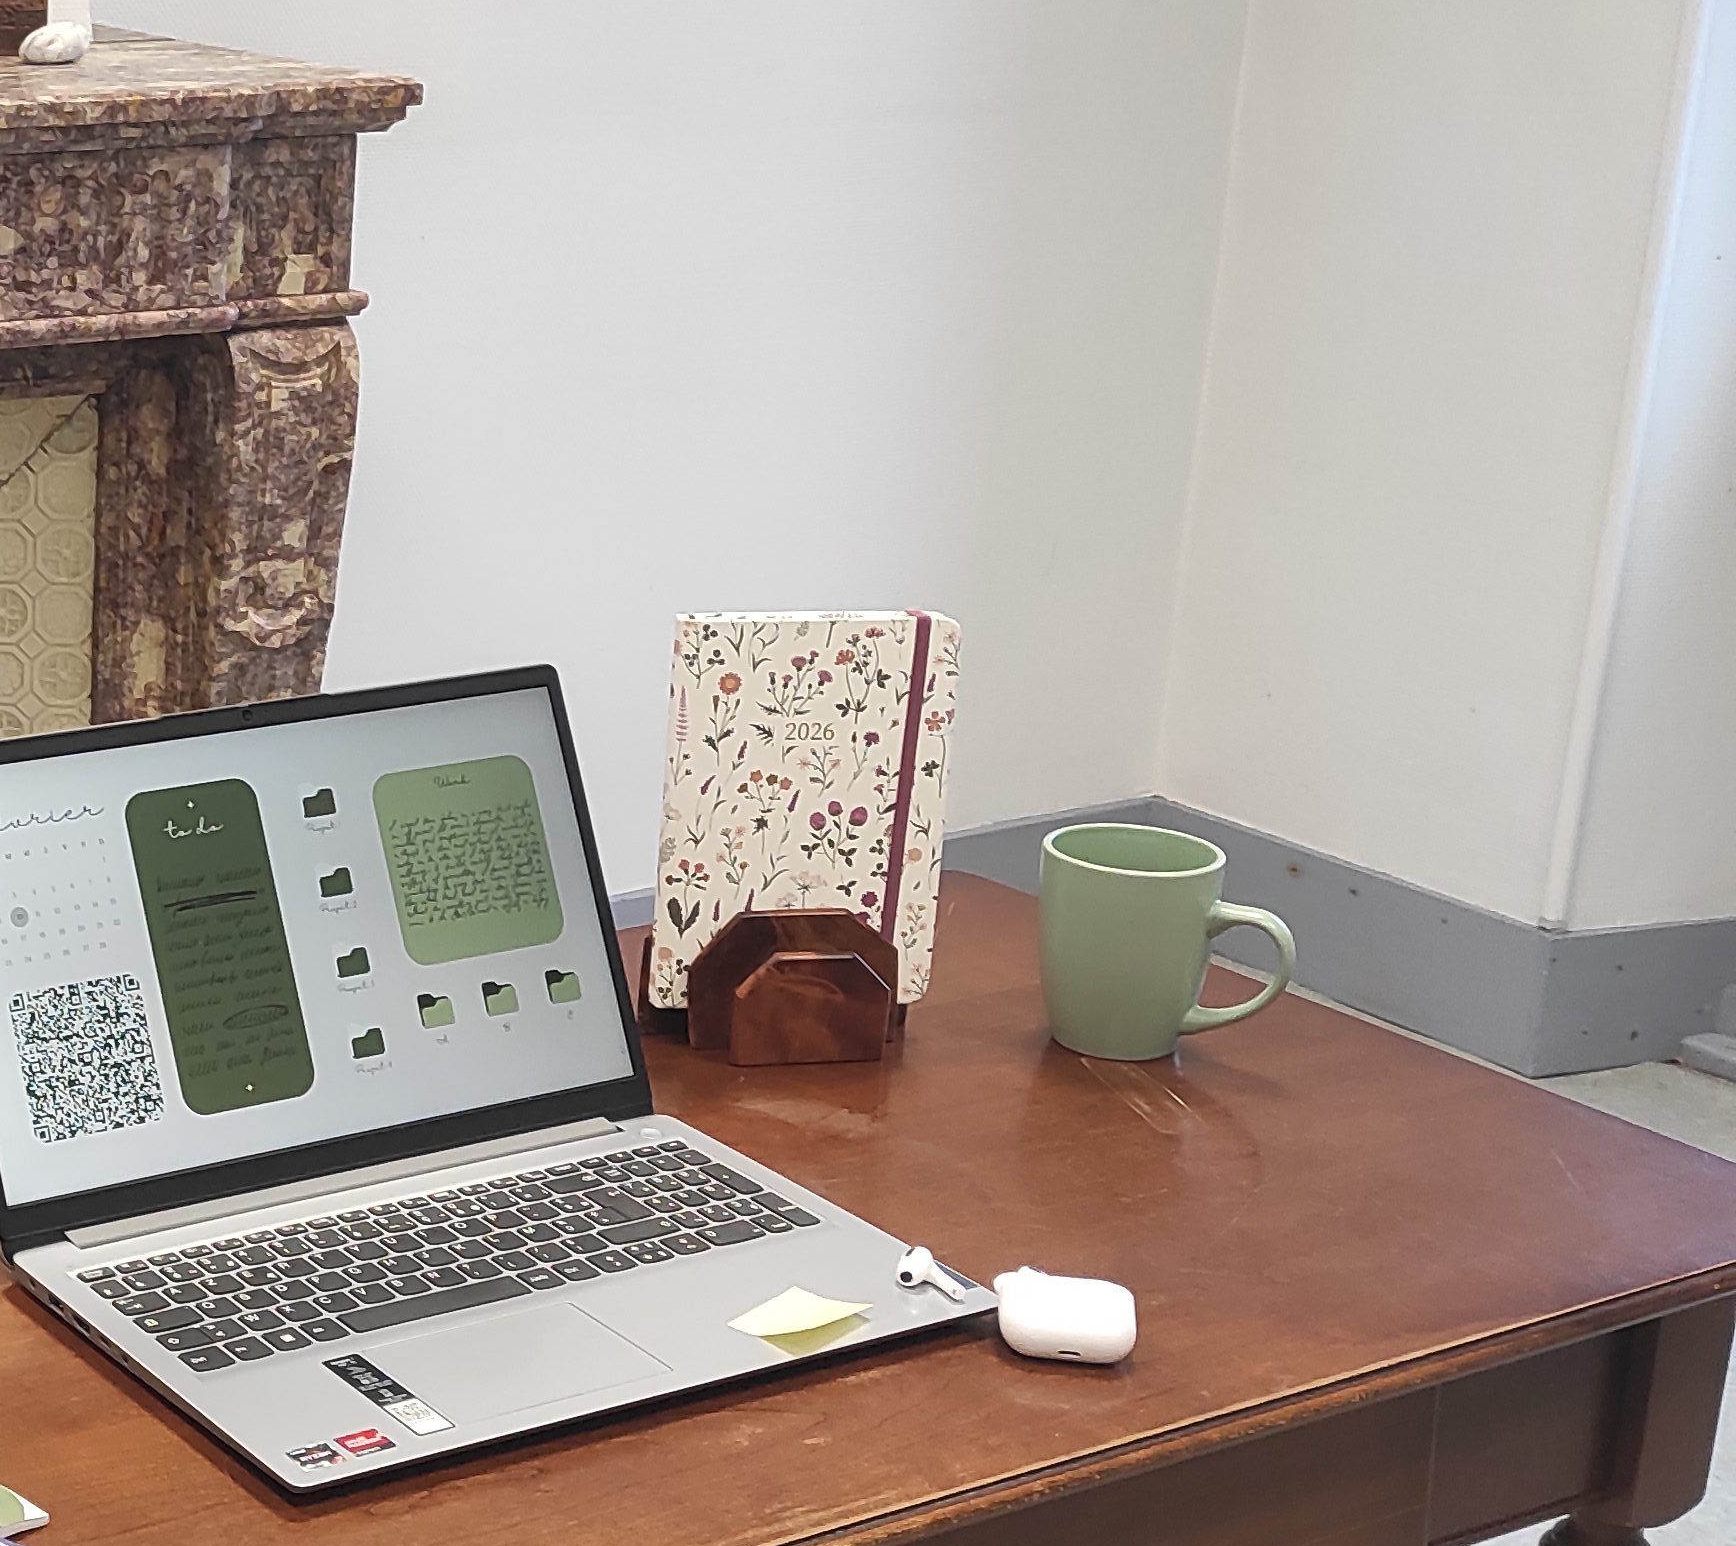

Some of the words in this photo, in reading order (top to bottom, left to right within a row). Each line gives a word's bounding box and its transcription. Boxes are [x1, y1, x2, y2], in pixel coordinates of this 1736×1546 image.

[785, 722, 835, 741] 2026
[162, 820, 193, 839] to
[196, 816, 224, 835] do
